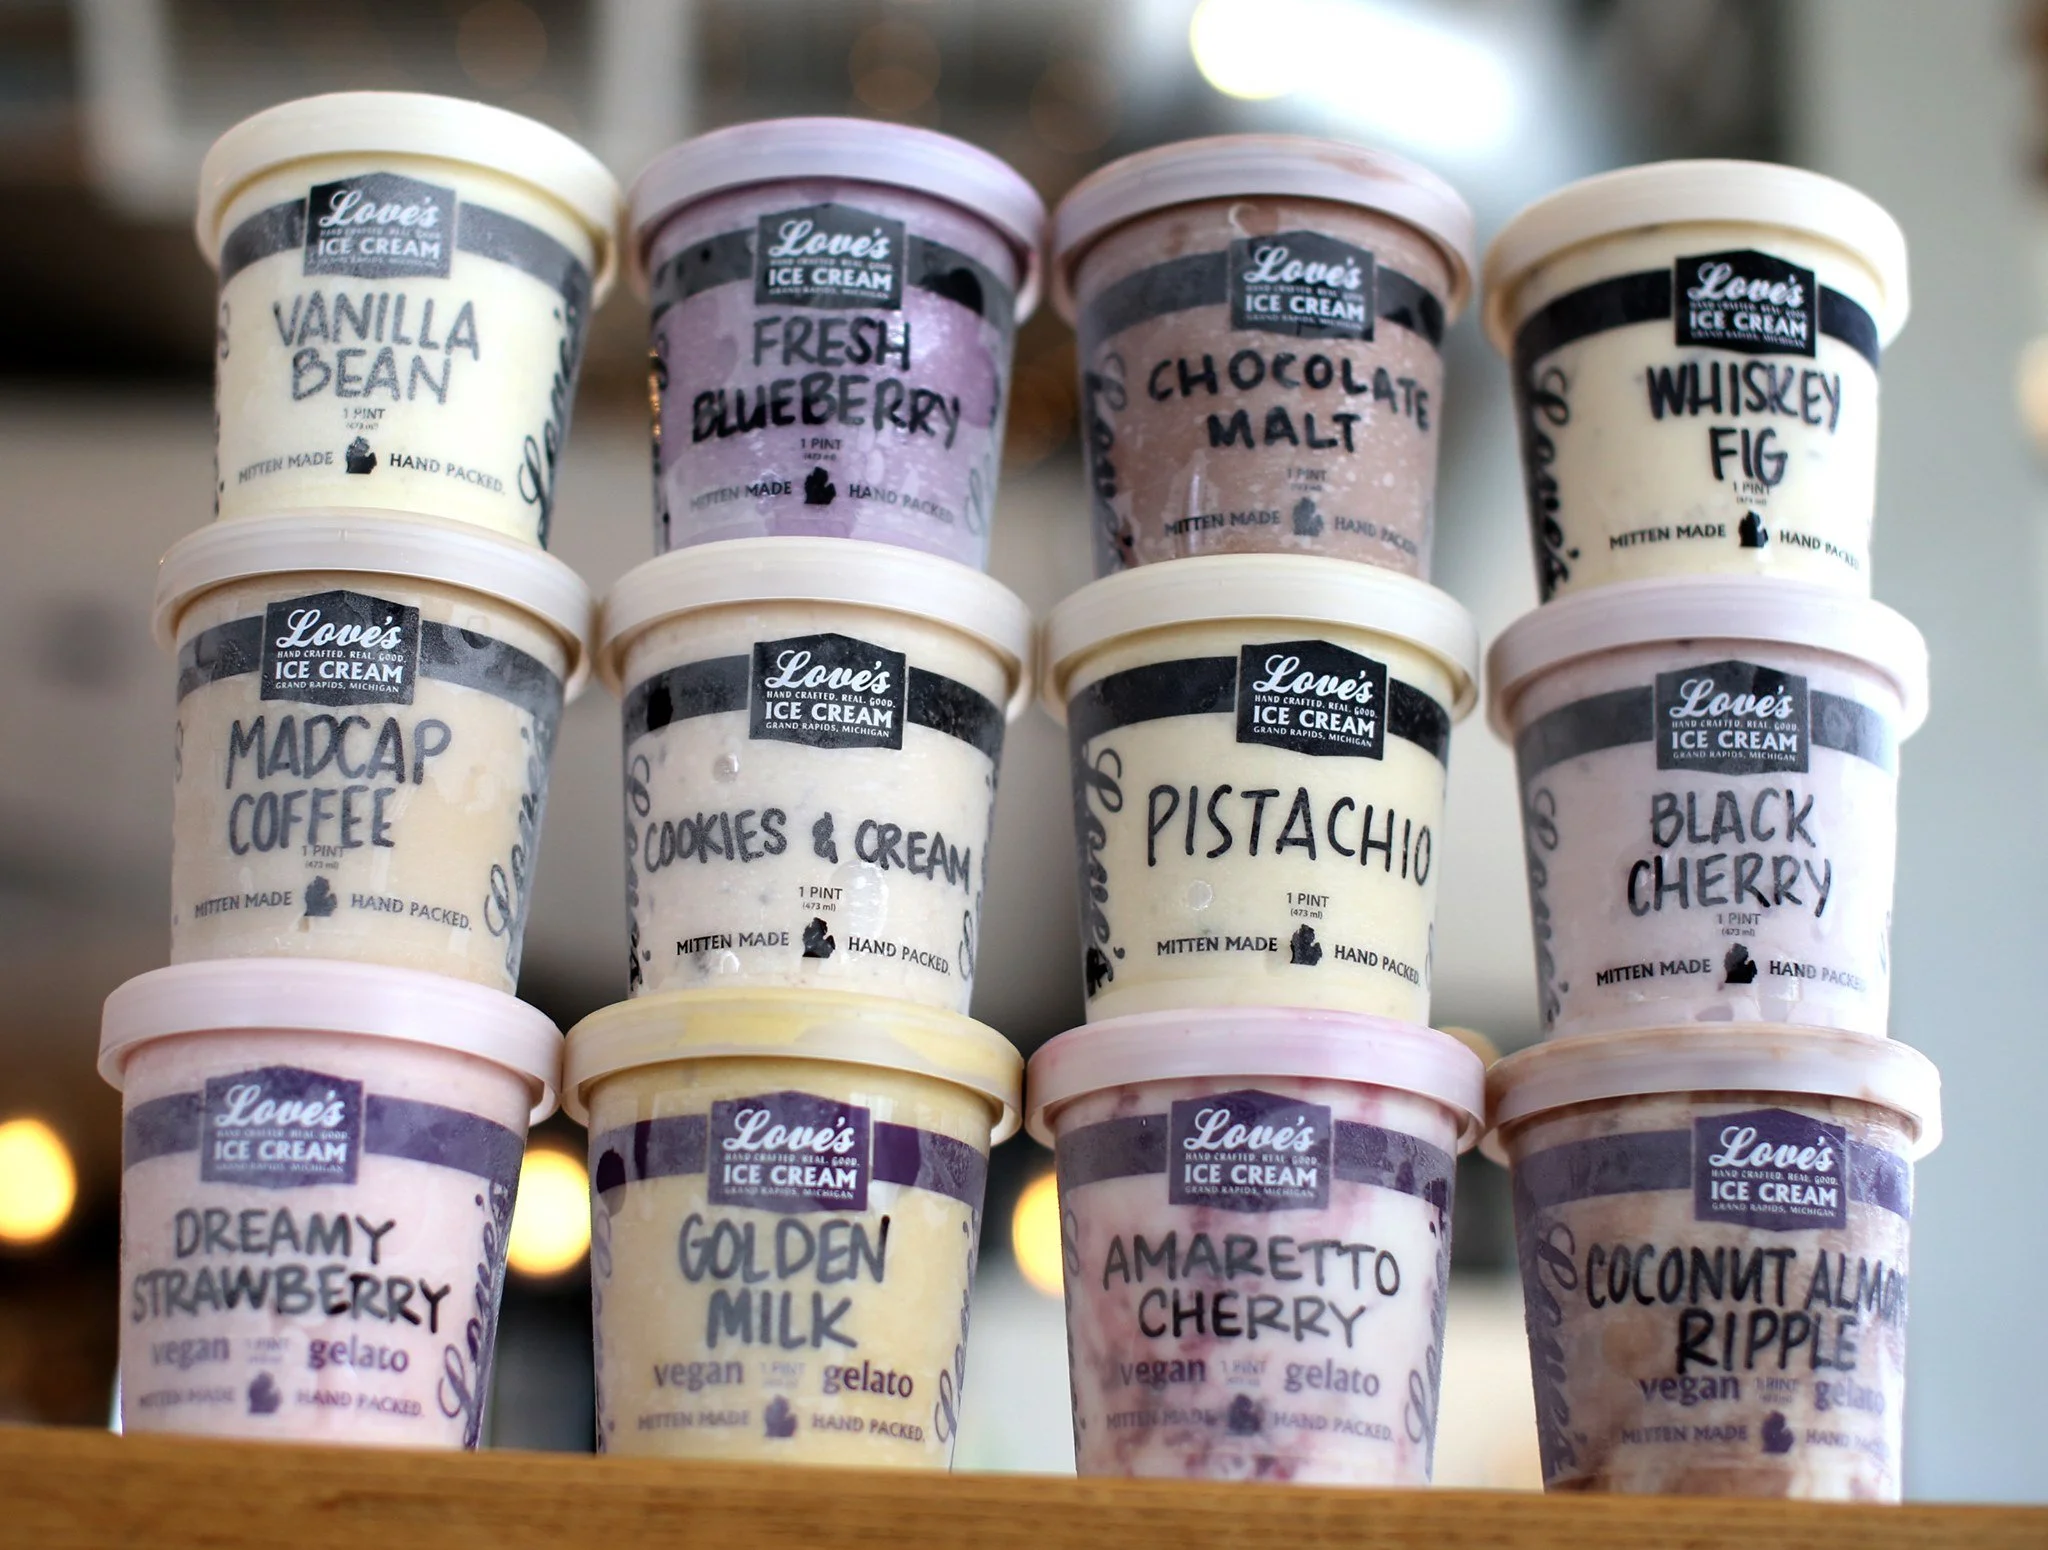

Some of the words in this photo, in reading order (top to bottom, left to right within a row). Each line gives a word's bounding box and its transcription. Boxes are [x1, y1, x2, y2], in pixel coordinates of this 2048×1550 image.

[319, 190, 439, 227] Love's
[318, 237, 353, 256] ICE
[360, 237, 441, 260] CREAM
[768, 220, 890, 259] Love's
[768, 268, 804, 286] ICE
[812, 268, 892, 291] CREAM
[1244, 246, 1362, 290] Love's
[1687, 262, 1804, 308] Love's
[272, 291, 481, 361] VANILLA
[1246, 295, 1281, 312] ICE
[1289, 296, 1364, 321] CREAM
[1690, 310, 1725, 329] ICE
[1733, 312, 1807, 340] CREAM
[752, 316, 911, 372] FRESH
[291, 347, 451, 405] BEAN
[1148, 350, 1429, 432] CHOCOLATE
[692, 371, 960, 450] BLUEBERRY
[1647, 360, 1841, 432] WHISKEY
[801, 439, 805, 448] 1
[811, 439, 841, 450] PINT
[1207, 406, 1361, 453] MALT
[239, 460, 283, 484] MITTEN
[288, 451, 334, 467] MADE
[390, 453, 440, 473] HAND
[1709, 426, 1788, 487] FIG
[745, 482, 792, 498] MADE
[849, 484, 897, 504] HAND
[1164, 514, 1224, 536] MITTEN
[1230, 511, 1281, 526] MADE
[1334, 517, 1376, 537] HAND
[1610, 526, 1670, 550] MITTEN
[1676, 524, 1726, 539] MADE
[1779, 530, 1820, 550] HAND
[276, 609, 402, 649] Love's
[275, 661, 310, 679] ICE
[319, 661, 403, 684] CREAM
[765, 650, 890, 694] Love's
[1253, 655, 1373, 703] Love's
[765, 701, 802, 720] ICE
[811, 702, 892, 728] CREAM
[1669, 679, 1793, 719] Love's
[1253, 706, 1290, 725] ICE
[1299, 709, 1375, 738] CREAM
[227, 714, 452, 789] MADCAP
[1672, 731, 1708, 749] ICE
[1718, 731, 1798, 752] CREAM
[229, 785, 397, 856] COFFEE
[1147, 783, 1431, 887] PISTACHIO
[1651, 787, 1816, 848] BLACK
[302, 846, 307, 857] 1
[312, 846, 344, 858] PINT
[644, 807, 788, 874] COOKIES
[812, 811, 839, 864] &
[854, 819, 971, 895] CREAM
[799, 887, 804, 897] 1
[810, 886, 843, 899] PINT
[1287, 893, 1292, 903] 1
[1298, 893, 1329, 908] PINT
[1628, 852, 1831, 918] CHERRY
[195, 895, 241, 918] MITTEN
[245, 891, 293, 907] MADE
[351, 894, 403, 914] HAND
[409, 901, 472, 931] PACKED.
[1717, 914, 1722, 924] 1
[1729, 913, 1761, 925] PINT
[677, 934, 732, 955] MITTEN
[739, 932, 789, 948] MADE
[848, 937, 897, 957] HAND
[902, 947, 950, 975] PACKED.
[1157, 938, 1218, 955] MITTEN
[1225, 937, 1278, 952] MADE
[1334, 945, 1378, 966] HAND
[1597, 963, 1653, 986] MITTEN
[1660, 959, 1711, 975] MADE
[1769, 961, 1817, 979] HAND
[214, 1084, 345, 1128] Love's
[723, 1109, 855, 1154] Love's
[1183, 1108, 1314, 1152] Love's
[214, 1140, 250, 1160] ICE
[258, 1140, 348, 1164] CREAM
[1708, 1126, 1834, 1172] Love's
[724, 1164, 761, 1185] ICE
[770, 1165, 858, 1190] CREAM
[1184, 1164, 1221, 1183] ICE
[1231, 1164, 1317, 1188] CREAM
[1711, 1181, 1750, 1200] ICE
[1758, 1182, 1838, 1208] CREAM
[174, 1207, 396, 1266] DREAMY
[678, 1213, 891, 1283] GOLDEN
[1102, 1230, 1401, 1297] AMARETTO
[1585, 1242, 1797, 1310] COCONUT
[132, 1264, 452, 1335] STRAWBERRY
[1138, 1287, 1366, 1349] CHERRY
[706, 1287, 858, 1350] MILK
[153, 1337, 231, 1371] vegan
[308, 1334, 410, 1372] gelato
[1676, 1307, 1860, 1375] RIPPLE
[654, 1361, 744, 1392] vegan
[823, 1360, 914, 1398] gelato
[1120, 1359, 1207, 1390] vegan
[1284, 1358, 1380, 1397] gelato
[1639, 1375, 1740, 1406] vegan
[812, 1413, 864, 1432] HAND
[1273, 1411, 1327, 1430] HAND
[1622, 1427, 1687, 1445] MITTEN
[1693, 1425, 1748, 1442] MADE
